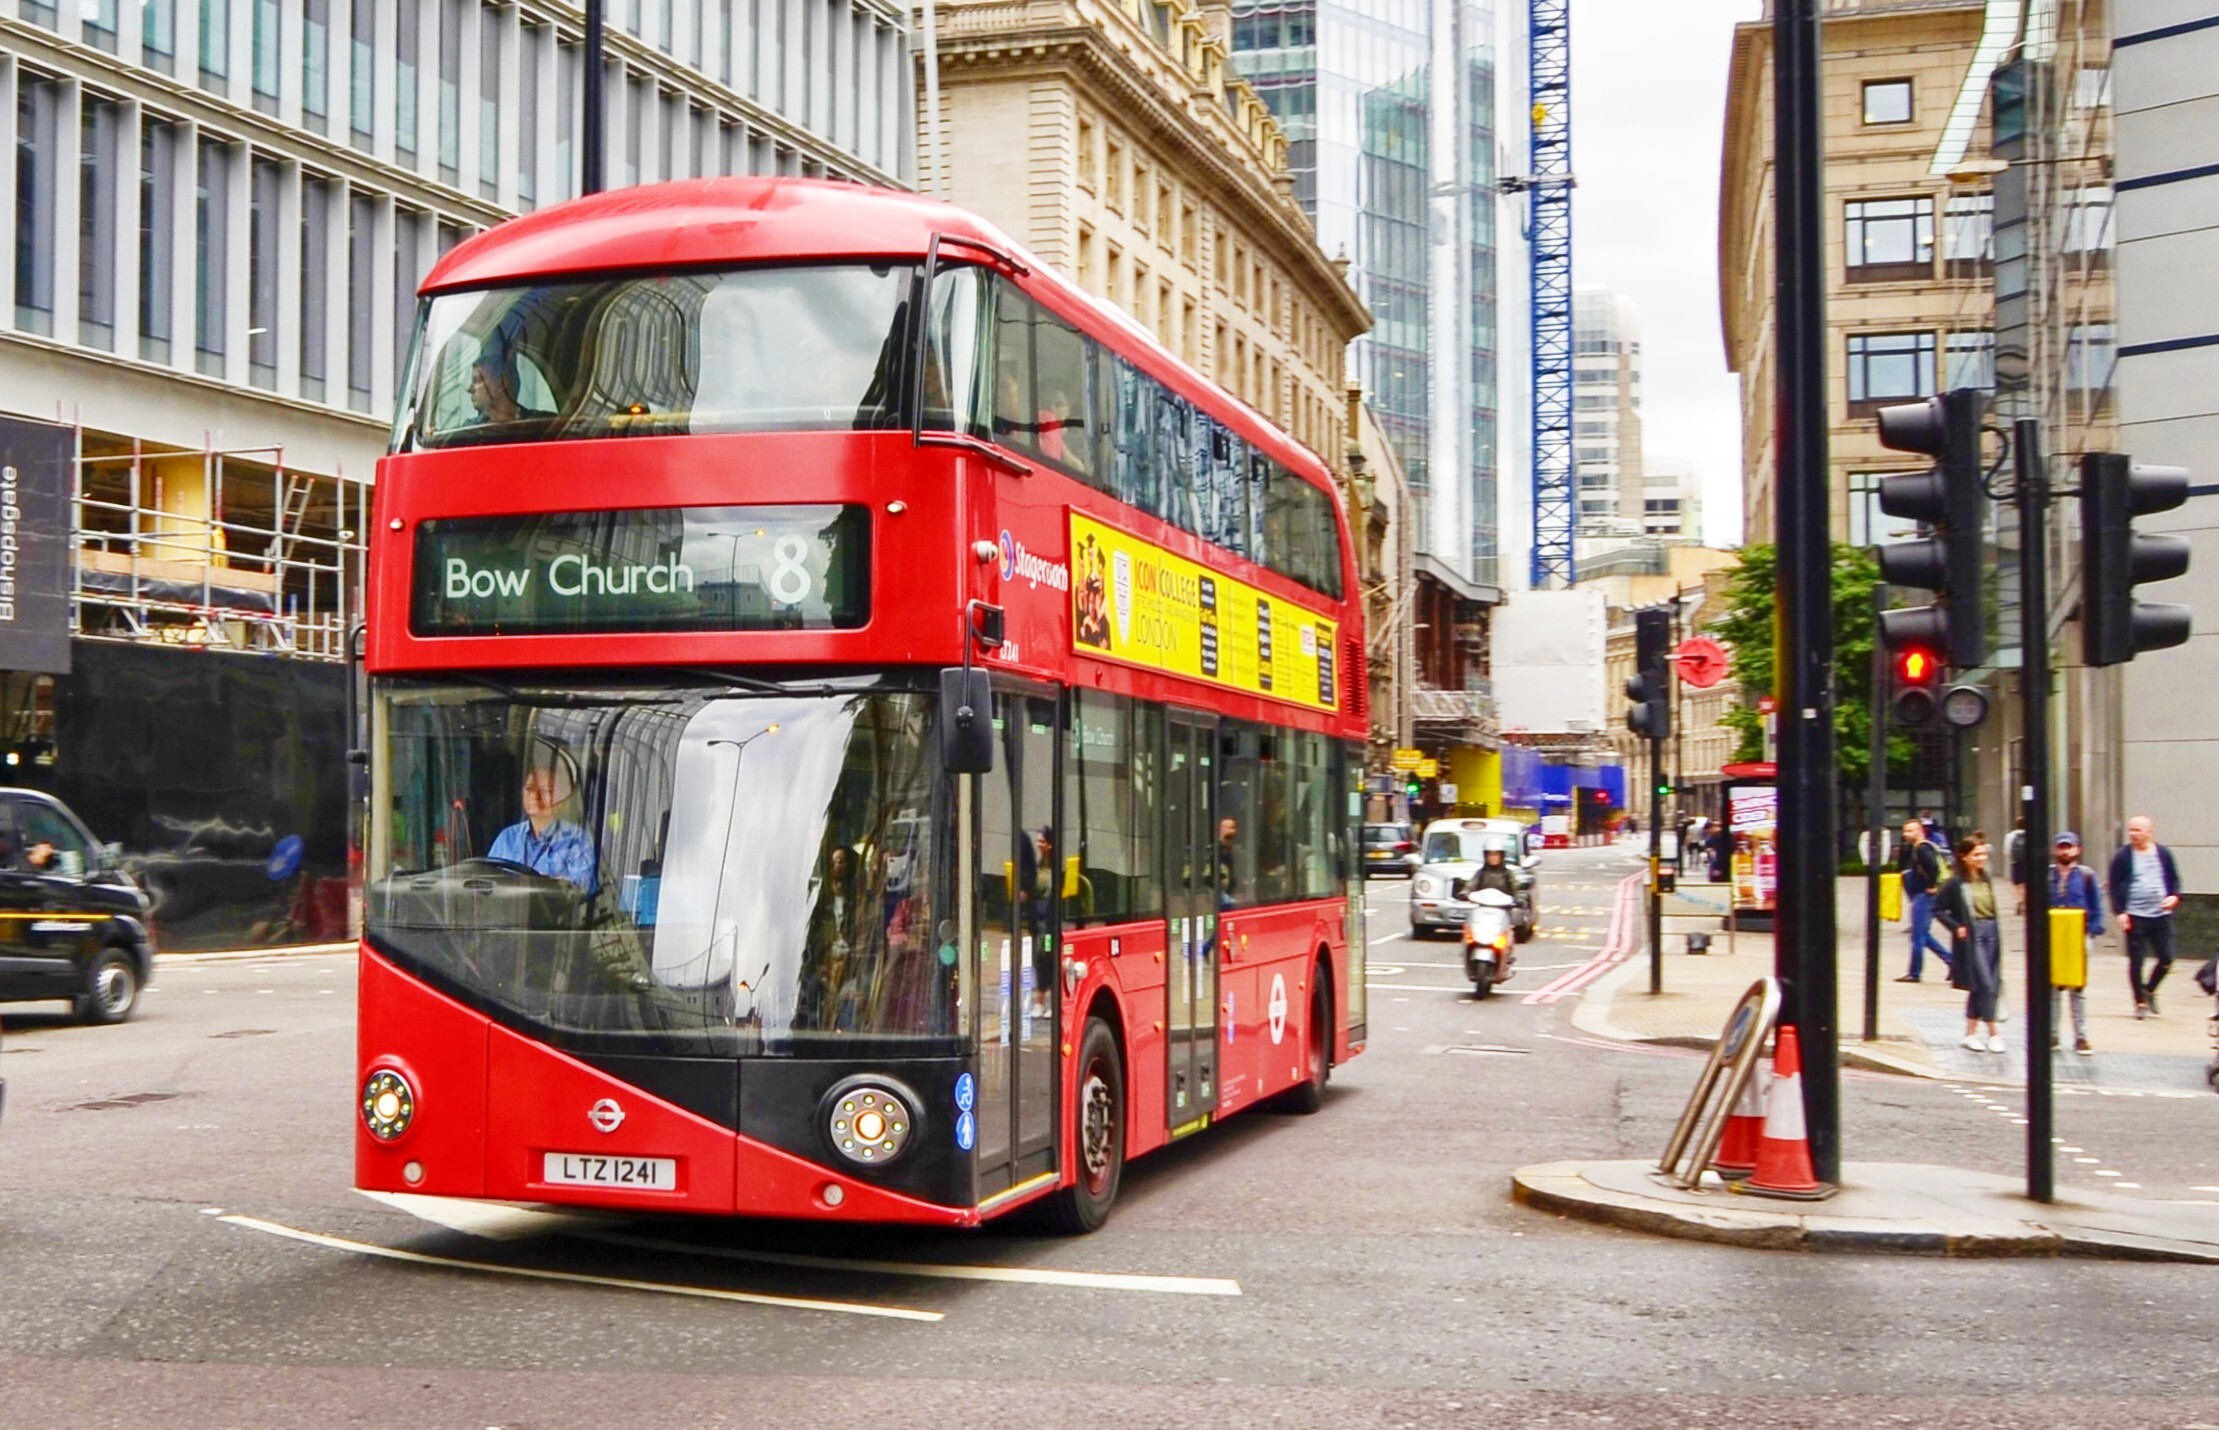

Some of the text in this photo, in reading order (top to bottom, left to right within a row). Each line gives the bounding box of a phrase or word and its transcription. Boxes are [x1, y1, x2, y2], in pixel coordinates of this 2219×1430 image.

[0, 465, 21, 620] Bishopsgate
[1014, 541, 1068, 592] Stagecoach
[446, 551, 694, 599] Bow Church
[769, 532, 813, 605] 8
[1135, 559, 1157, 595] ICON
[1161, 568, 1197, 608] COLLEGE
[1136, 611, 1177, 653] LONDON
[563, 1157, 656, 1184] LTZ 1241
